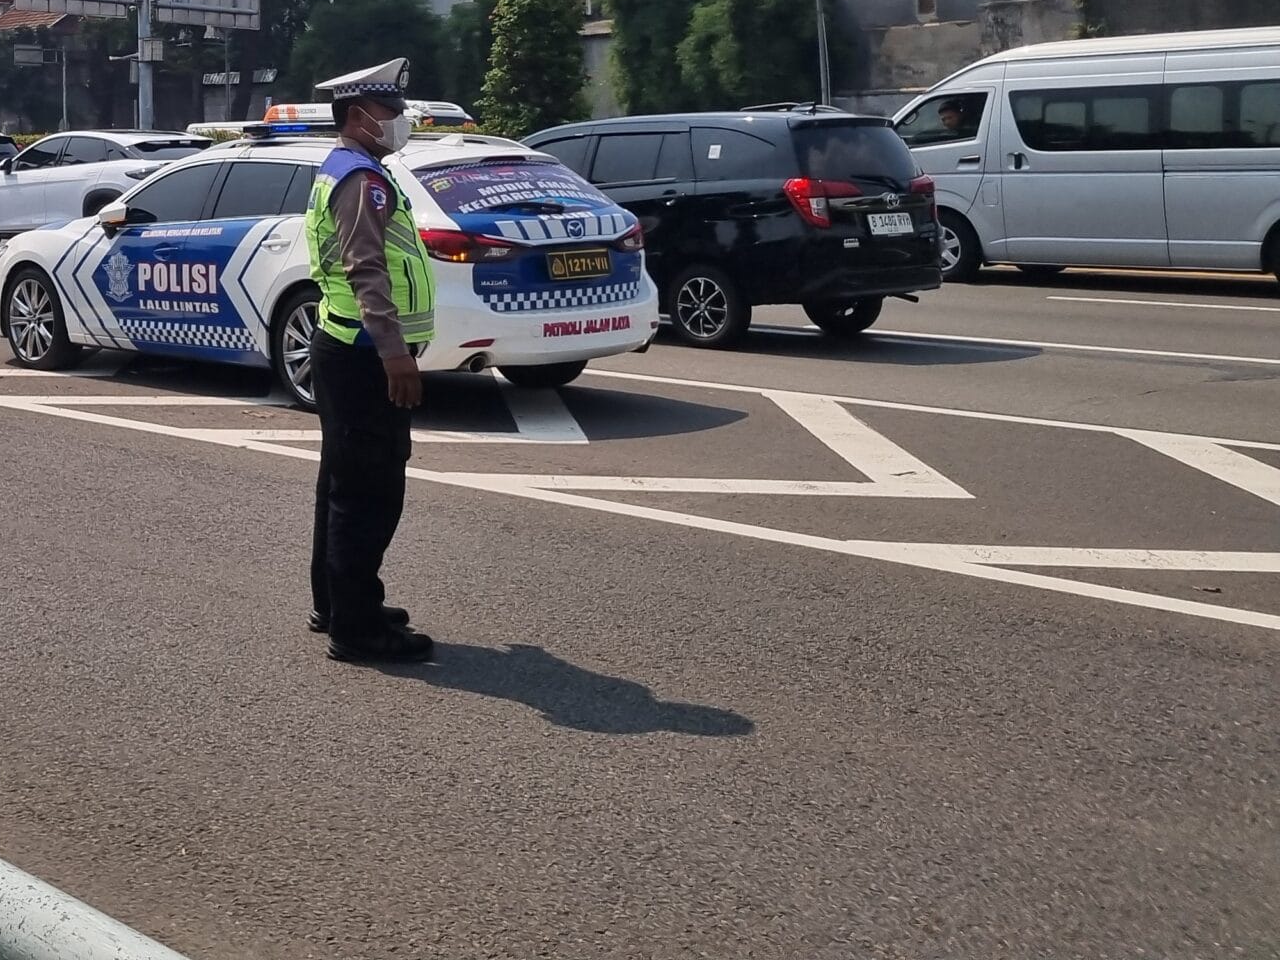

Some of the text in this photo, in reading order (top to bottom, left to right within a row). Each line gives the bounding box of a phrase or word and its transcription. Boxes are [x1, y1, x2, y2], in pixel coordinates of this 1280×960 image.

[477, 180, 581, 197] MUDIK AMAN
[458, 190, 546, 214] KELUARGA
[137, 262, 217, 294] POLISI
[139, 299, 219, 314] LALU LINTAS
[543, 315, 631, 338] PATROLI JALAN RAYA
